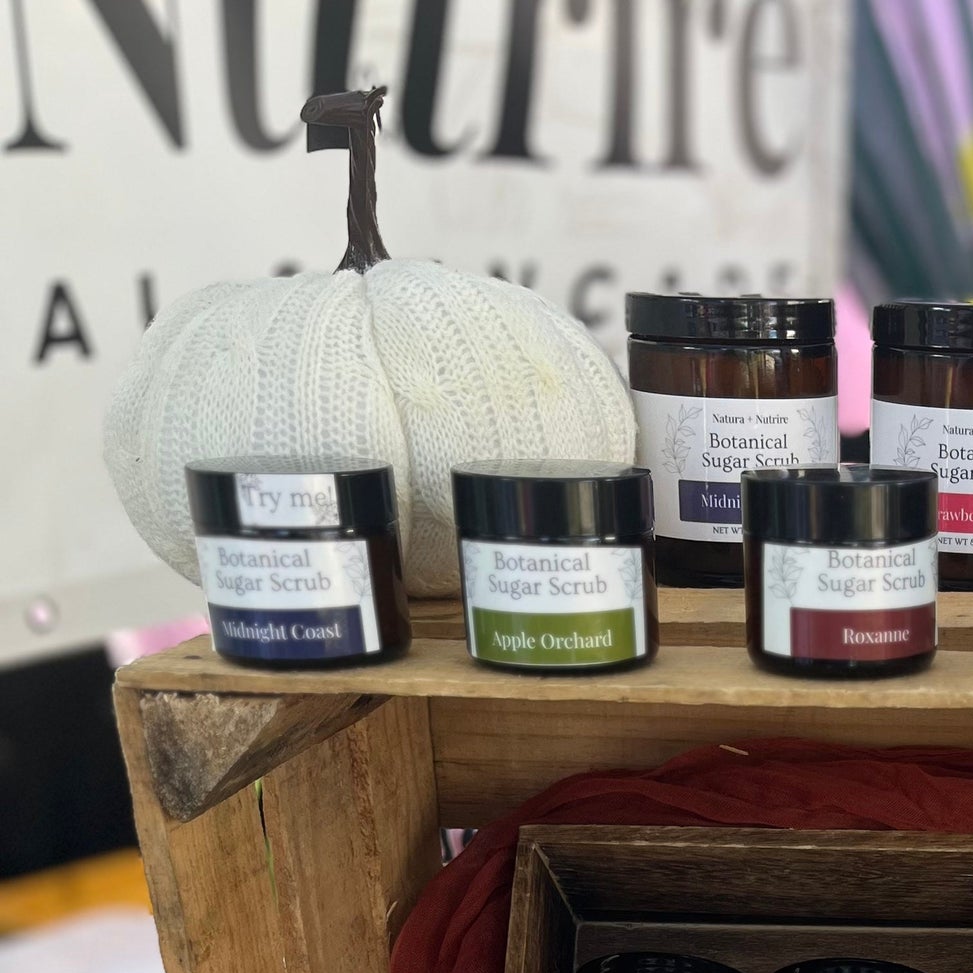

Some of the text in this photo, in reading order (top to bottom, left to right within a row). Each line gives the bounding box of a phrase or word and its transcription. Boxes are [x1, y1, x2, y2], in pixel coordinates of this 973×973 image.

[712, 413, 745, 425] Natura
[755, 413, 789, 425] Nutrire
[709, 432, 788, 450] Botanical
[942, 425, 973, 437] Natura
[702, 452, 800, 473] Sugar Scrub
[241, 484, 334, 514] Try me!
[701, 493, 741, 509] Midni
[955, 538, 968, 546] WT
[218, 547, 311, 568] Botanical
[494, 551, 592, 573] Botanical
[827, 548, 916, 569] Botanical
[217, 571, 332, 596] Sugar Scrub
[488, 574, 608, 600] Sugar Scrub
[817, 570, 926, 598] Sugar Scrub
[222, 620, 343, 644] Midnight Coast
[492, 629, 613, 651] Apple Orchard
[842, 627, 911, 644] Roxanne
